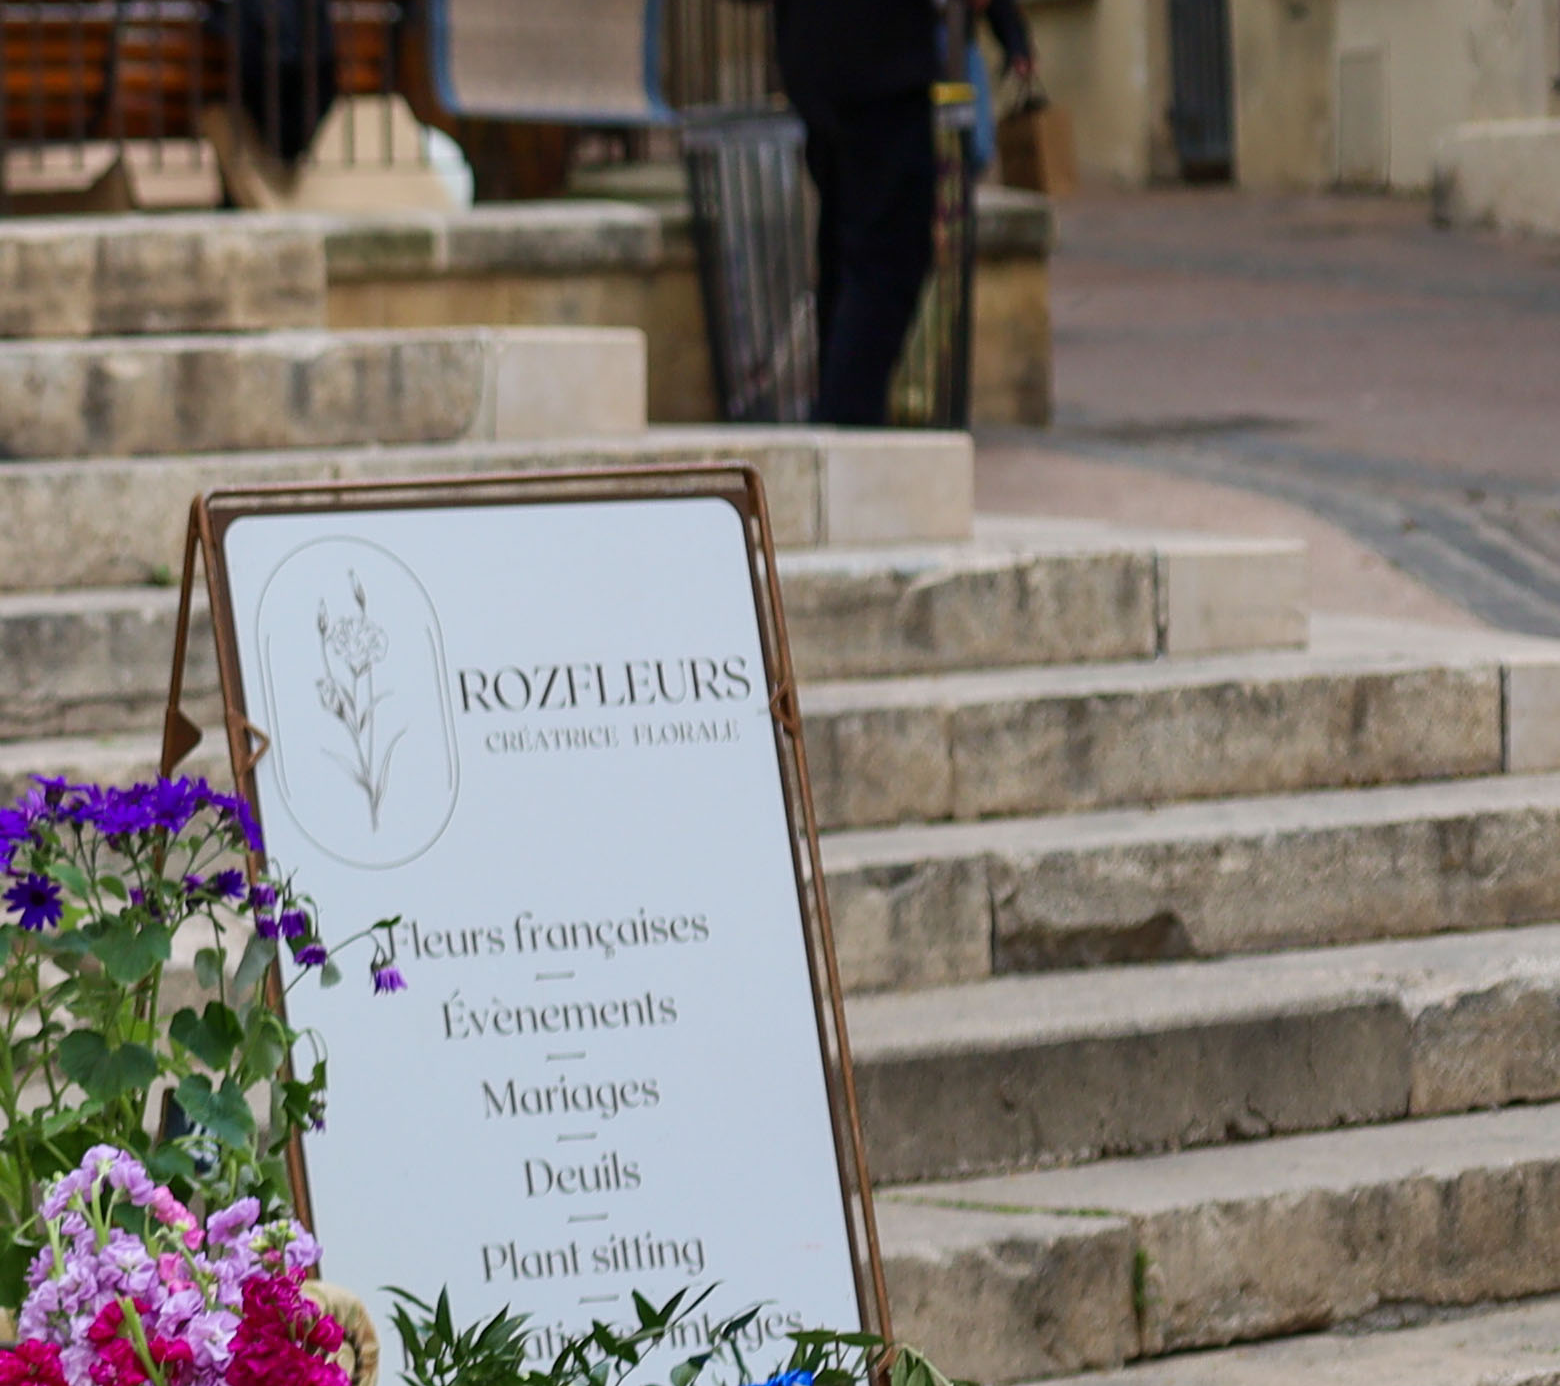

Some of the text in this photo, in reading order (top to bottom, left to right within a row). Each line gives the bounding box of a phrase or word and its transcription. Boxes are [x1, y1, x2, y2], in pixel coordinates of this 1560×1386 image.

[459, 656, 751, 713] ROZFLEURS
[486, 719, 739, 754] CRÉATRICE FLORALE
[514, 907, 709, 960] françaises
[442, 990, 677, 1039] Évènements
[482, 1073, 660, 1119] Mariages
[524, 1151, 641, 1198] Deuils
[482, 1231, 705, 1283] Plant sitting
